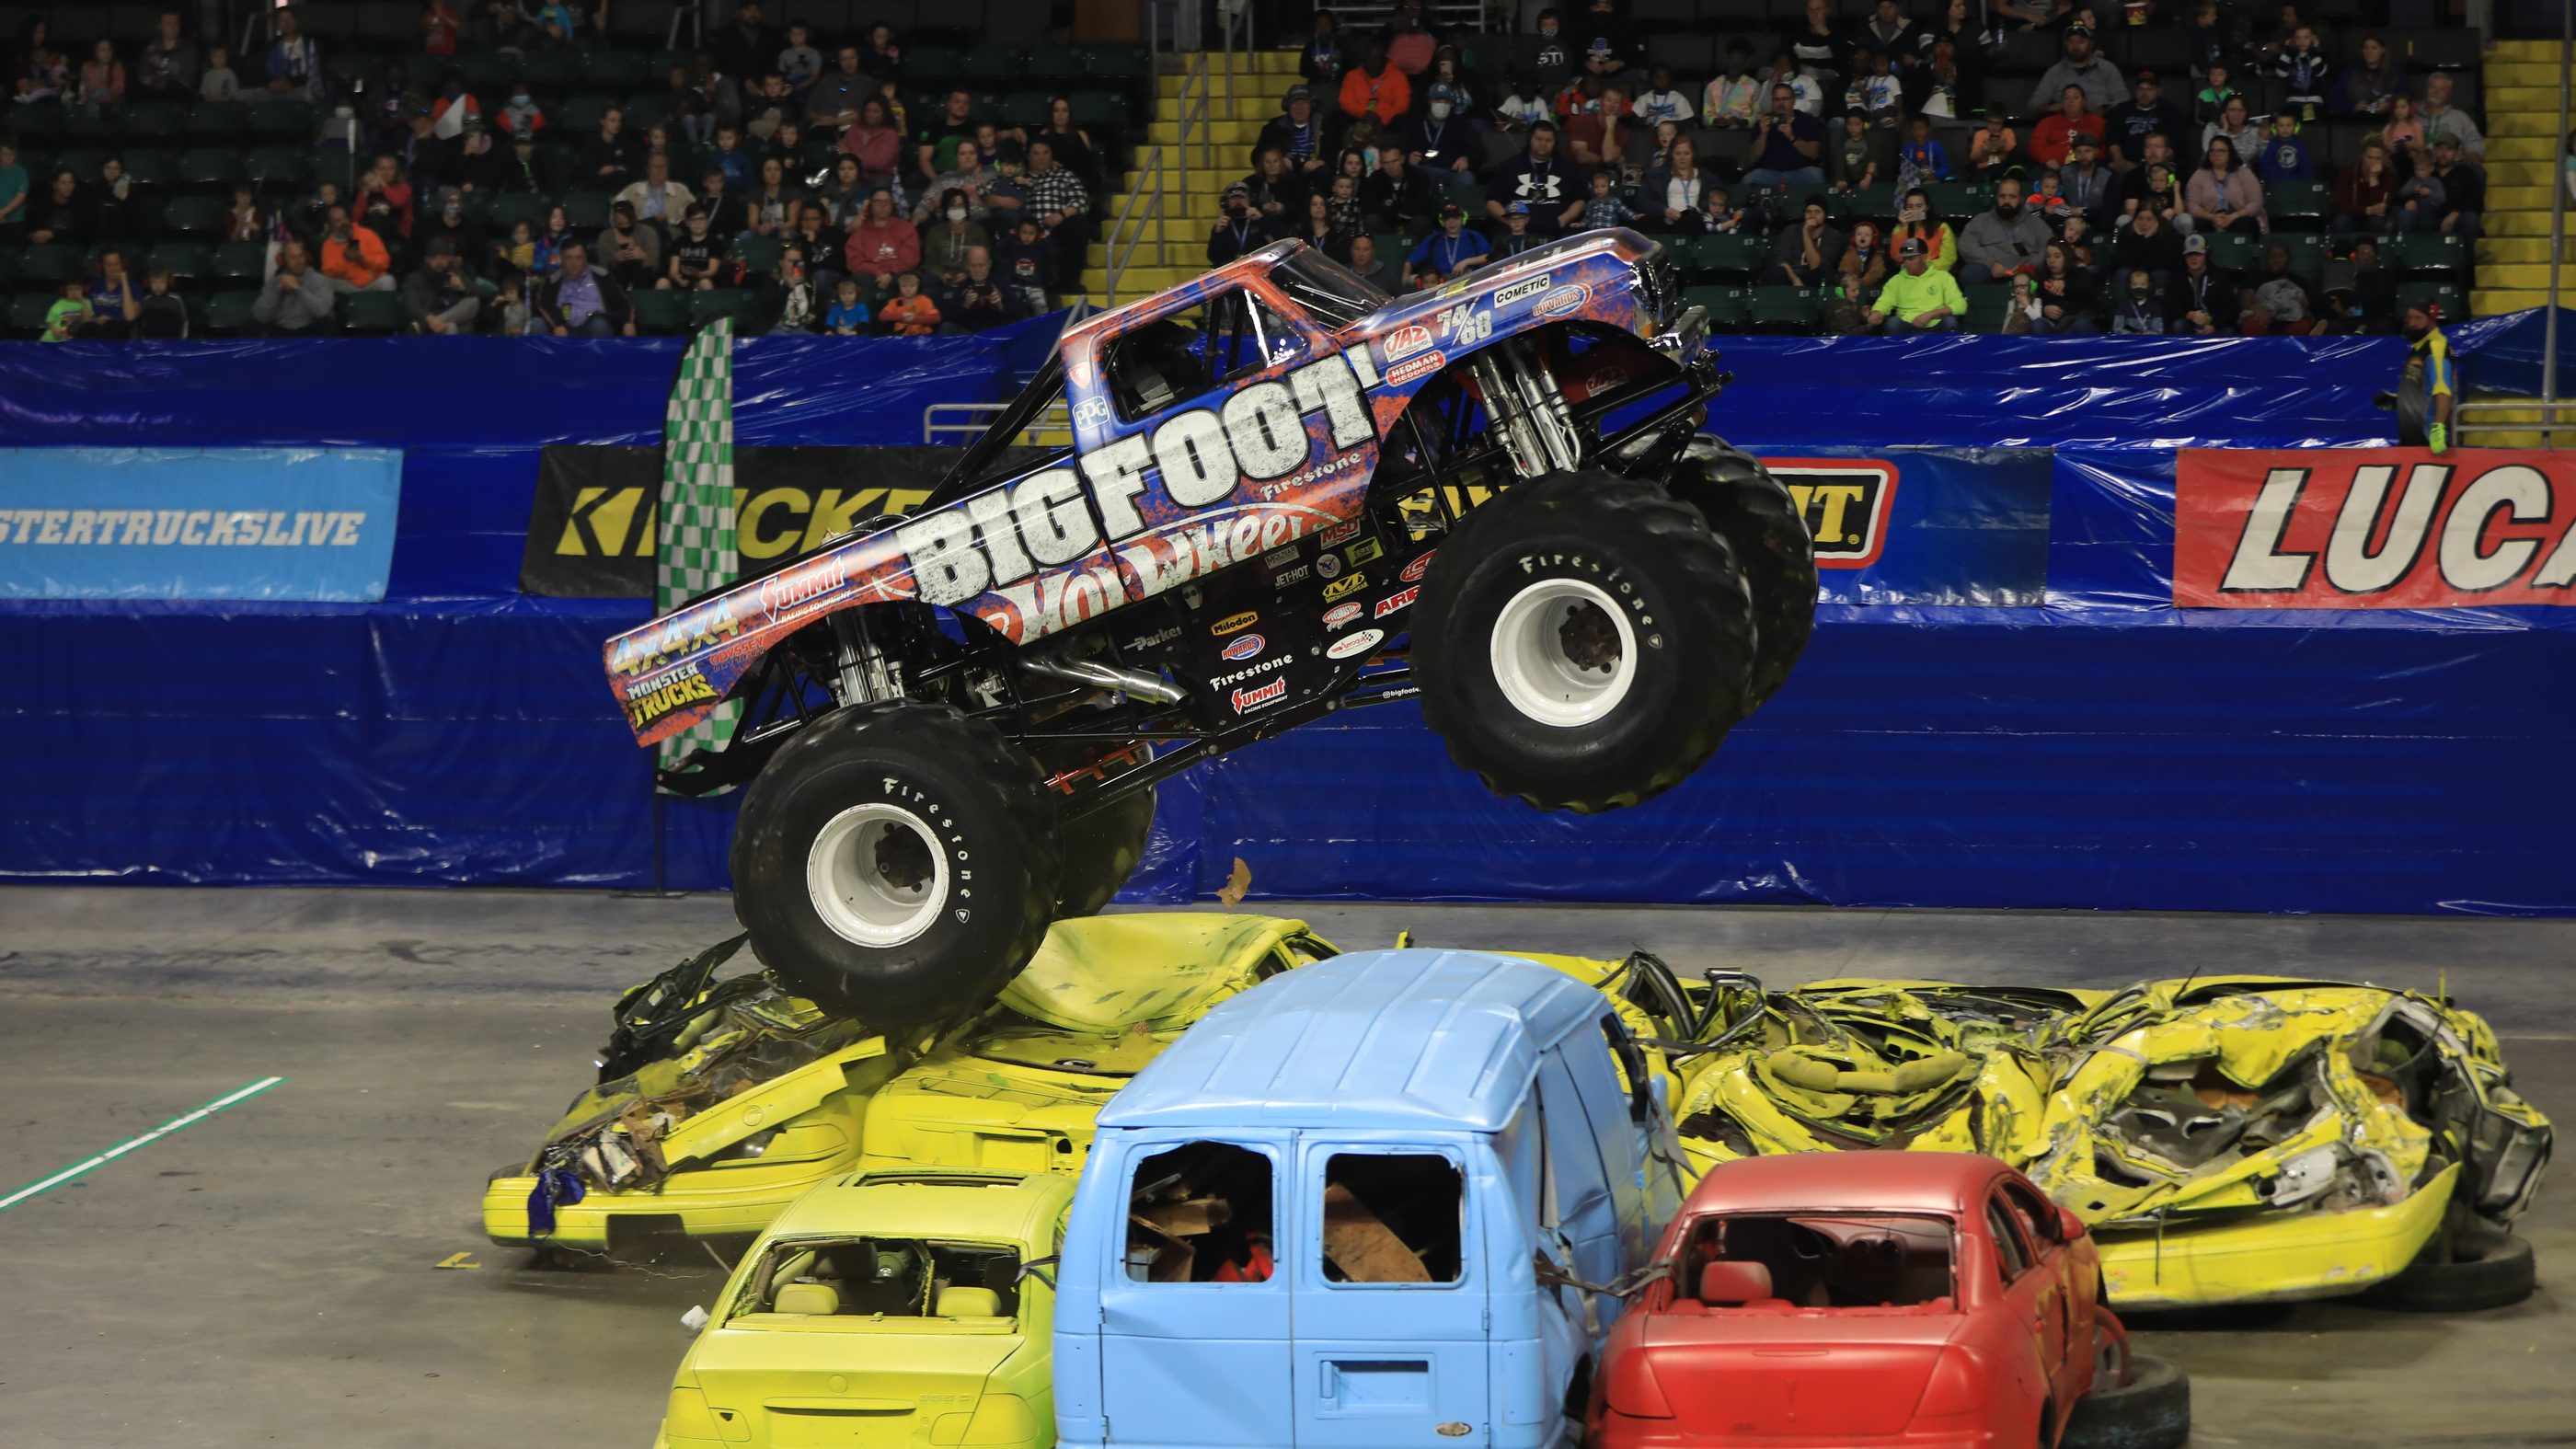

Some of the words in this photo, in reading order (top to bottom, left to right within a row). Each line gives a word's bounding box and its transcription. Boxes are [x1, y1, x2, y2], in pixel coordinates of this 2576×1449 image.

[1496, 278, 1548, 304] COMETIC
[1532, 290, 1581, 317] HOWARDS
[1385, 327, 1427, 351] JAZ
[1391, 354, 1439, 378] HEDMAN
[1393, 362, 1441, 384] HEDDERS
[1075, 402, 1107, 425] PPG
[896, 341, 1380, 608] BIGFOOT
[1259, 453, 1362, 501] Firestone
[1322, 520, 1360, 544] MSD
[1110, 513, 1331, 604] Wheel
[1267, 546, 1297, 565] MOLNAR
[1353, 546, 1374, 559] ESAB
[760, 556, 846, 624] SUMMIT
[1518, 554, 1653, 627] Firestone
[613, 598, 739, 676] 4x4x4
[1213, 614, 1256, 635] Milodon
[708, 636, 765, 666] ODYSSEY
[1222, 638, 1258, 661] HOWARDS
[627, 661, 700, 700] MONSTER
[1209, 654, 1294, 692] Firestone
[628, 673, 720, 730] TRUCKS
[1231, 675, 1286, 716] SUMMIT
[1244, 703, 1261, 715] RACING
[1261, 695, 1289, 709] EQUIPMENT
[882, 777, 972, 899] Firestone
